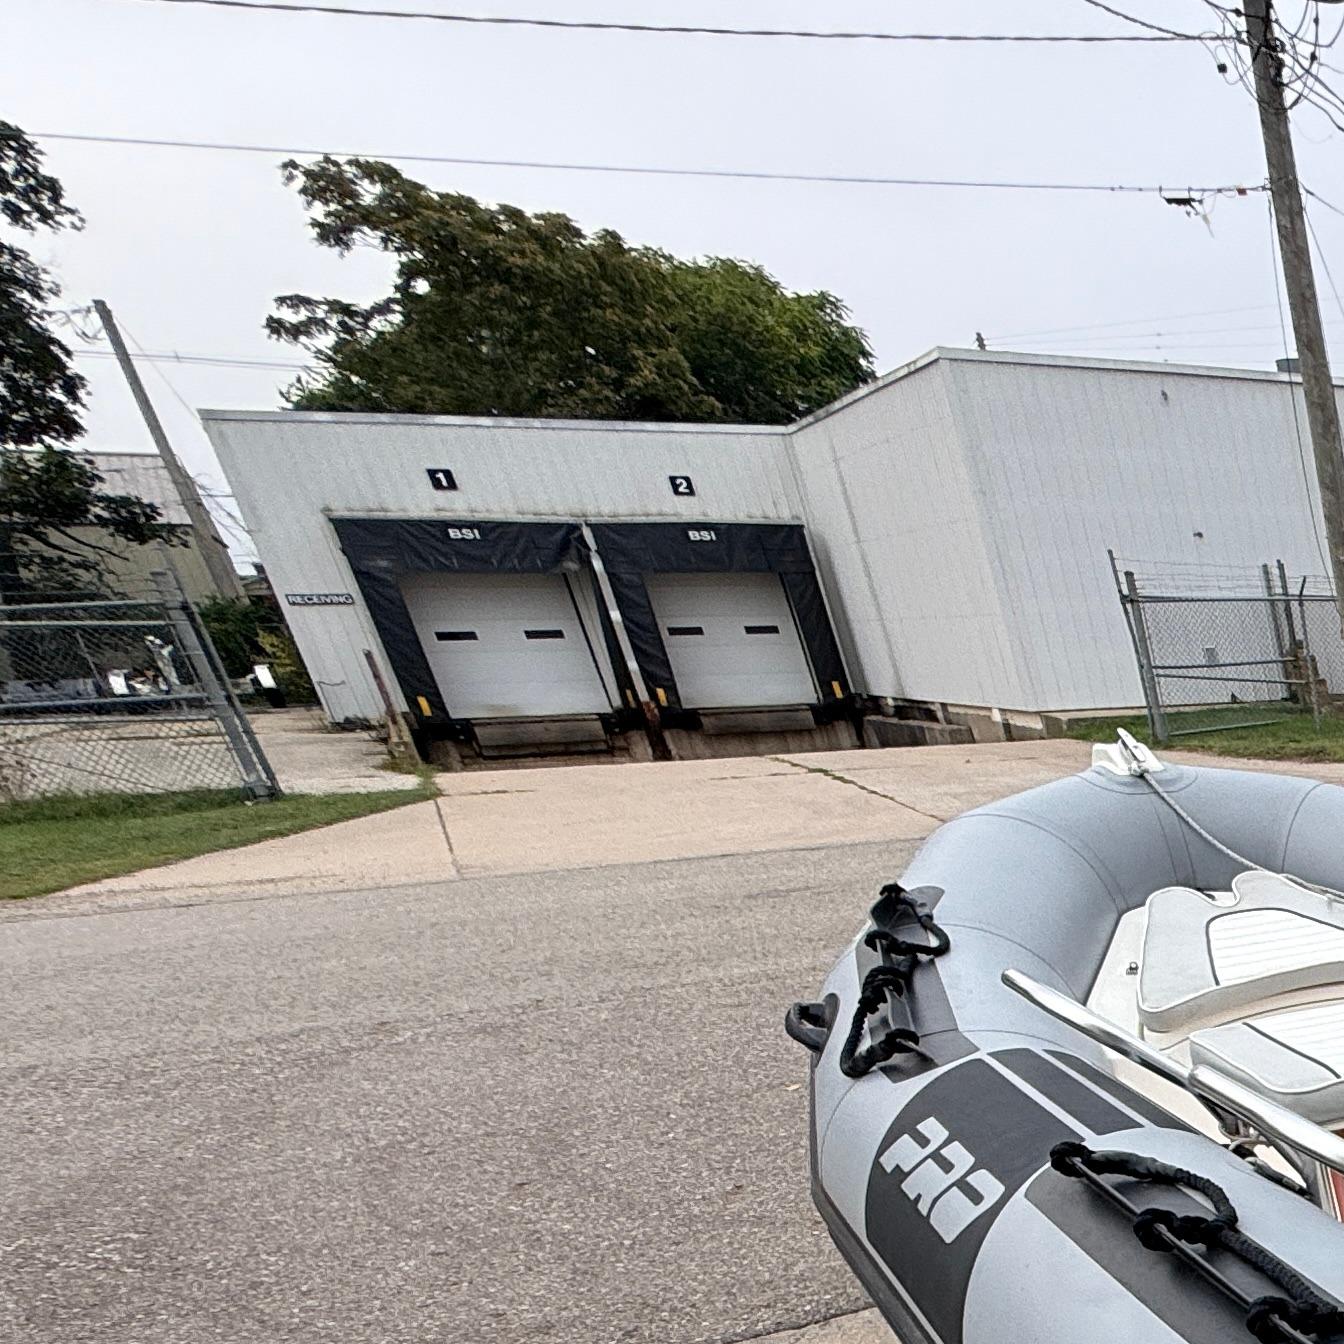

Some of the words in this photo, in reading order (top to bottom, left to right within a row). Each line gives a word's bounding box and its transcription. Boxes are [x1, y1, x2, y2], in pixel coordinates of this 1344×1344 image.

[435, 472, 449, 487] 1
[675, 478, 690, 493] 2
[447, 528, 480, 540] BSI
[687, 530, 716, 541] BSI
[287, 594, 353, 604] RECEIVING
[879, 1116, 1006, 1244] PRO
